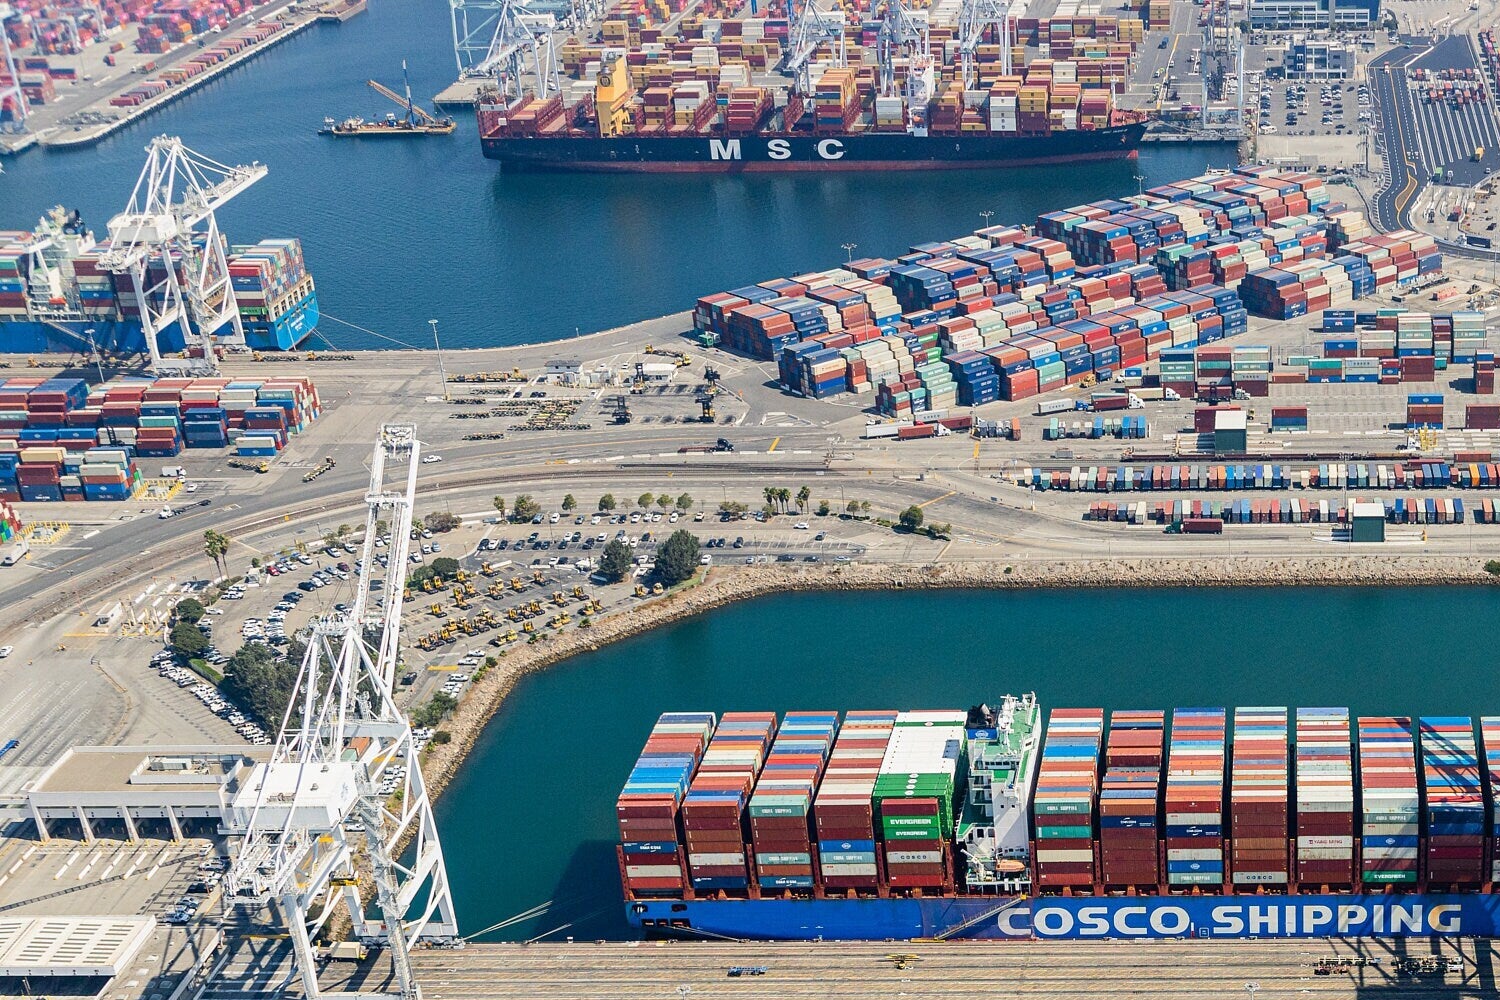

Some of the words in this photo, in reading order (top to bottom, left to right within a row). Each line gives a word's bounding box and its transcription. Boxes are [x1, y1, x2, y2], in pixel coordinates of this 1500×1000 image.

[710, 139, 843, 159] MSC
[997, 906, 1190, 935] COSCO
[1212, 905, 1461, 933] SHIPPING
